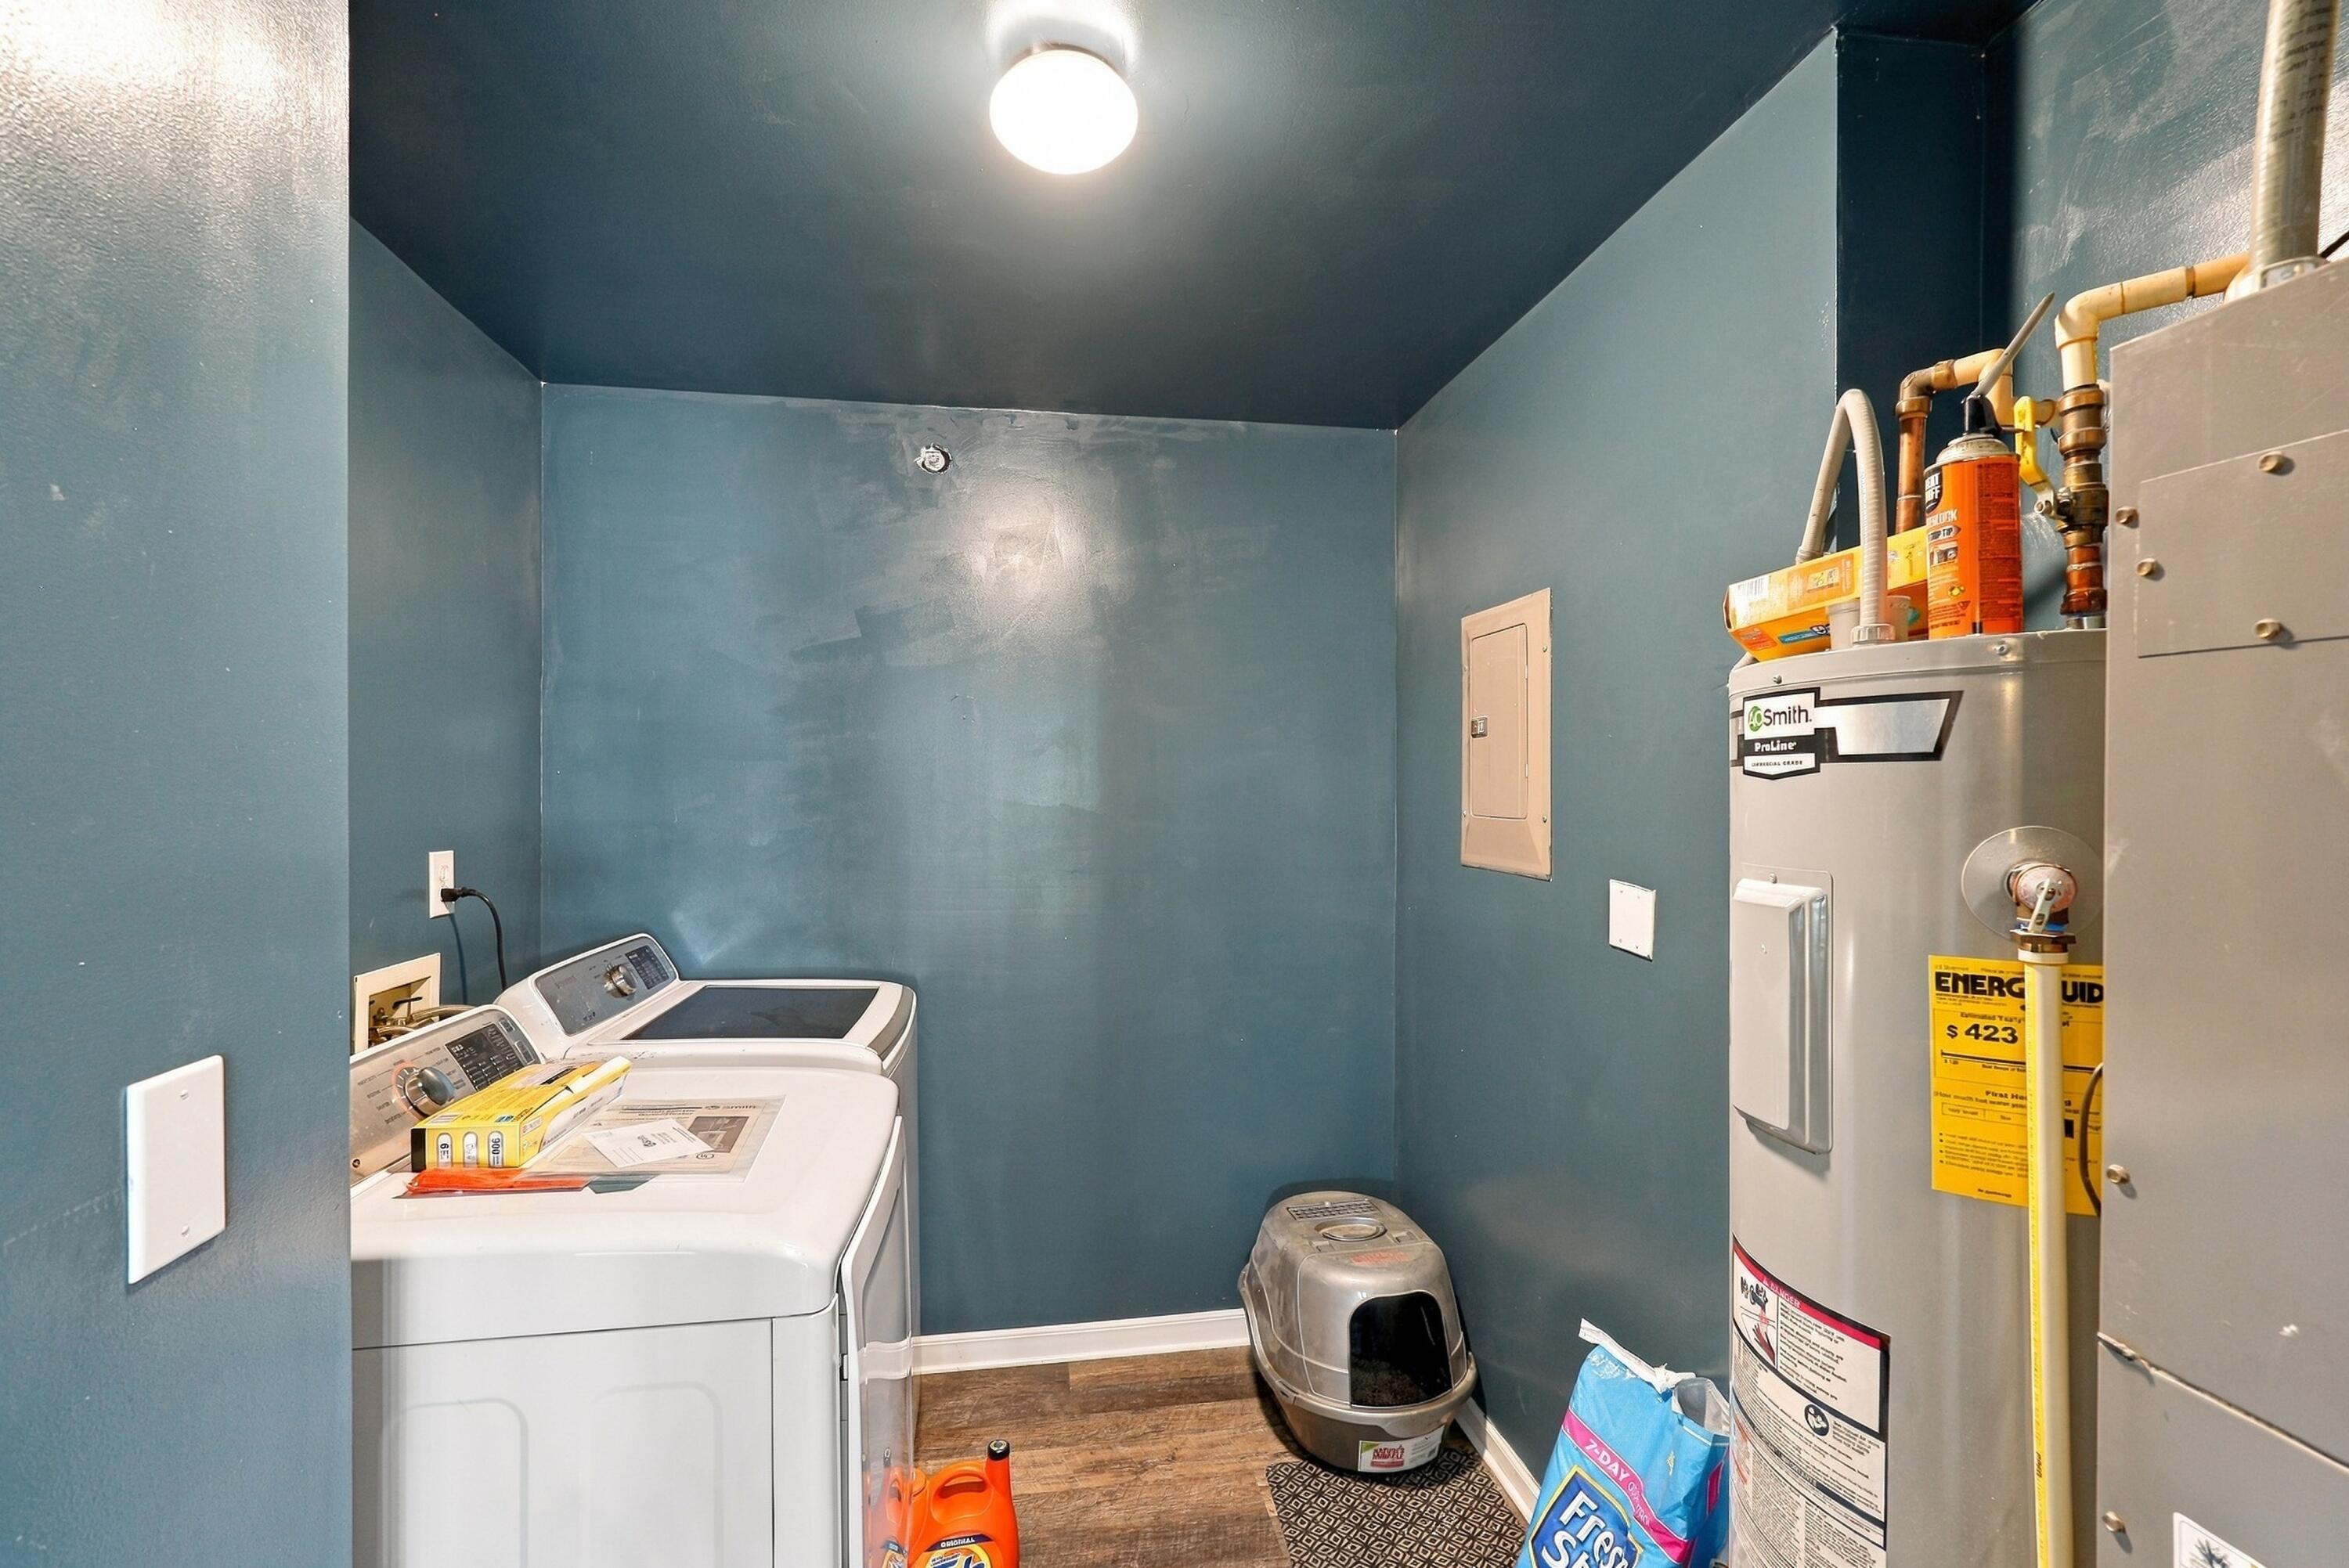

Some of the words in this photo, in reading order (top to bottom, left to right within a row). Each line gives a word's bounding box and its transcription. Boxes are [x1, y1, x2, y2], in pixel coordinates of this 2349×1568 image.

[1935, 971, 2025, 999] ENERG
[1965, 1023, 2019, 1044] 423
[1585, 1439, 1630, 1482] 7-DAY
